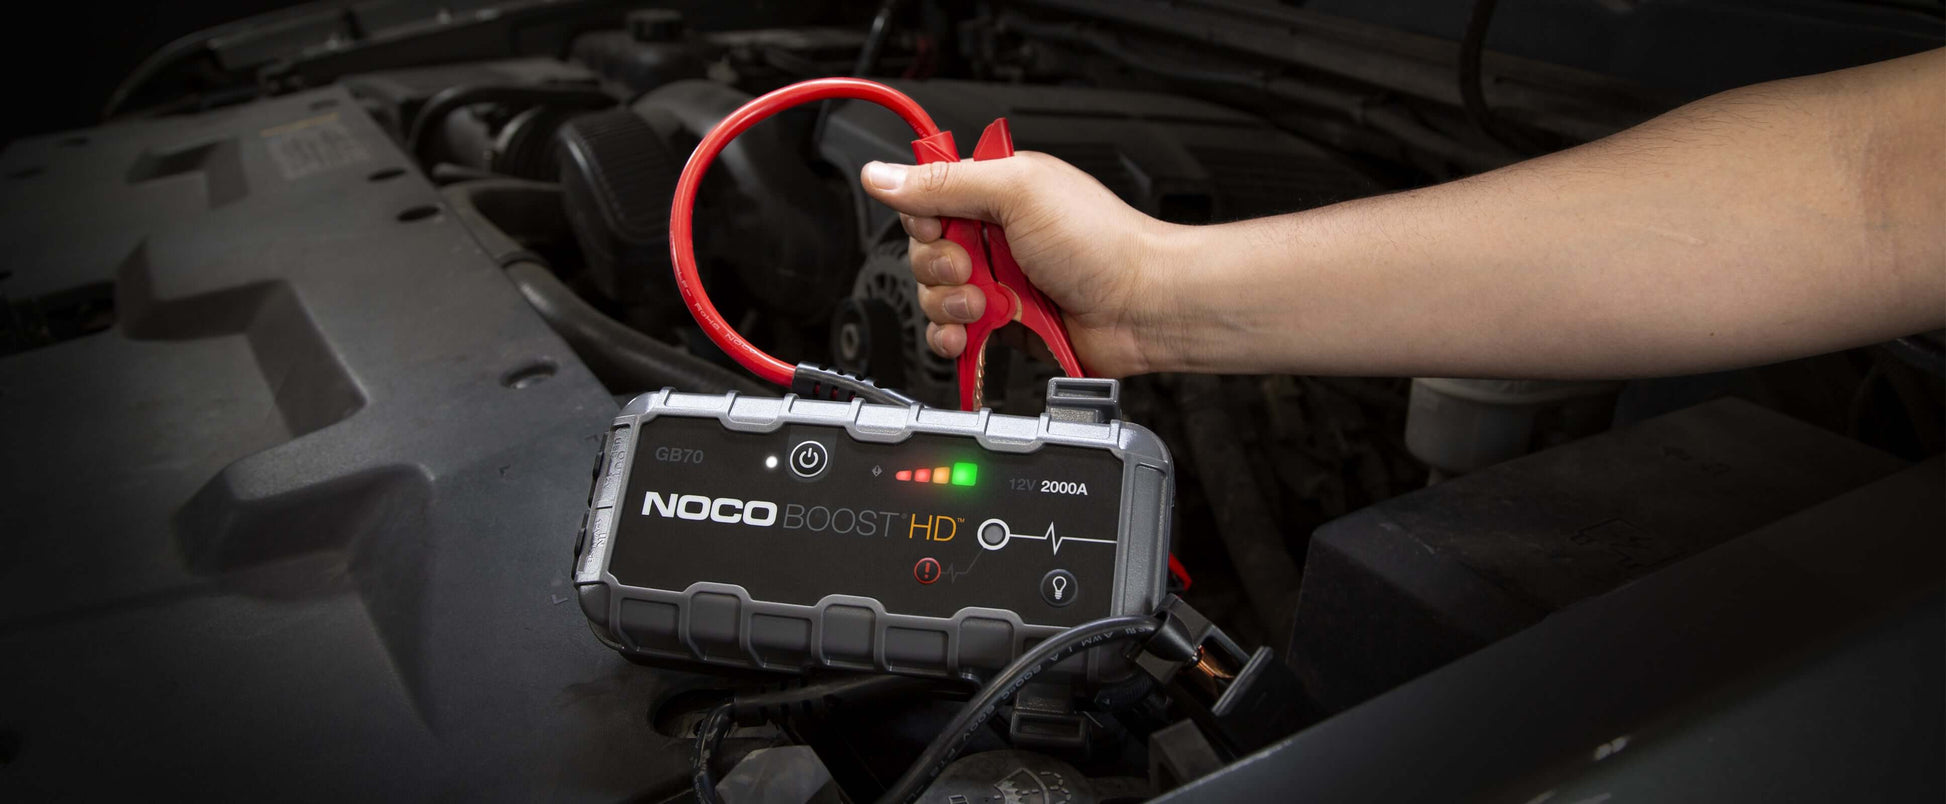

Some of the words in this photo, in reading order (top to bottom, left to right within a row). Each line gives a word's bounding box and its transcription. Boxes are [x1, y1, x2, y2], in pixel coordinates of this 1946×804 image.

[655, 446, 704, 464] GB70
[1009, 478, 1036, 492] 12V
[1040, 479, 1089, 496] 2000A
[641, 491, 778, 527] NOCO
[783, 503, 900, 538] BOOST
[1079, 630, 1115, 648] AWM
